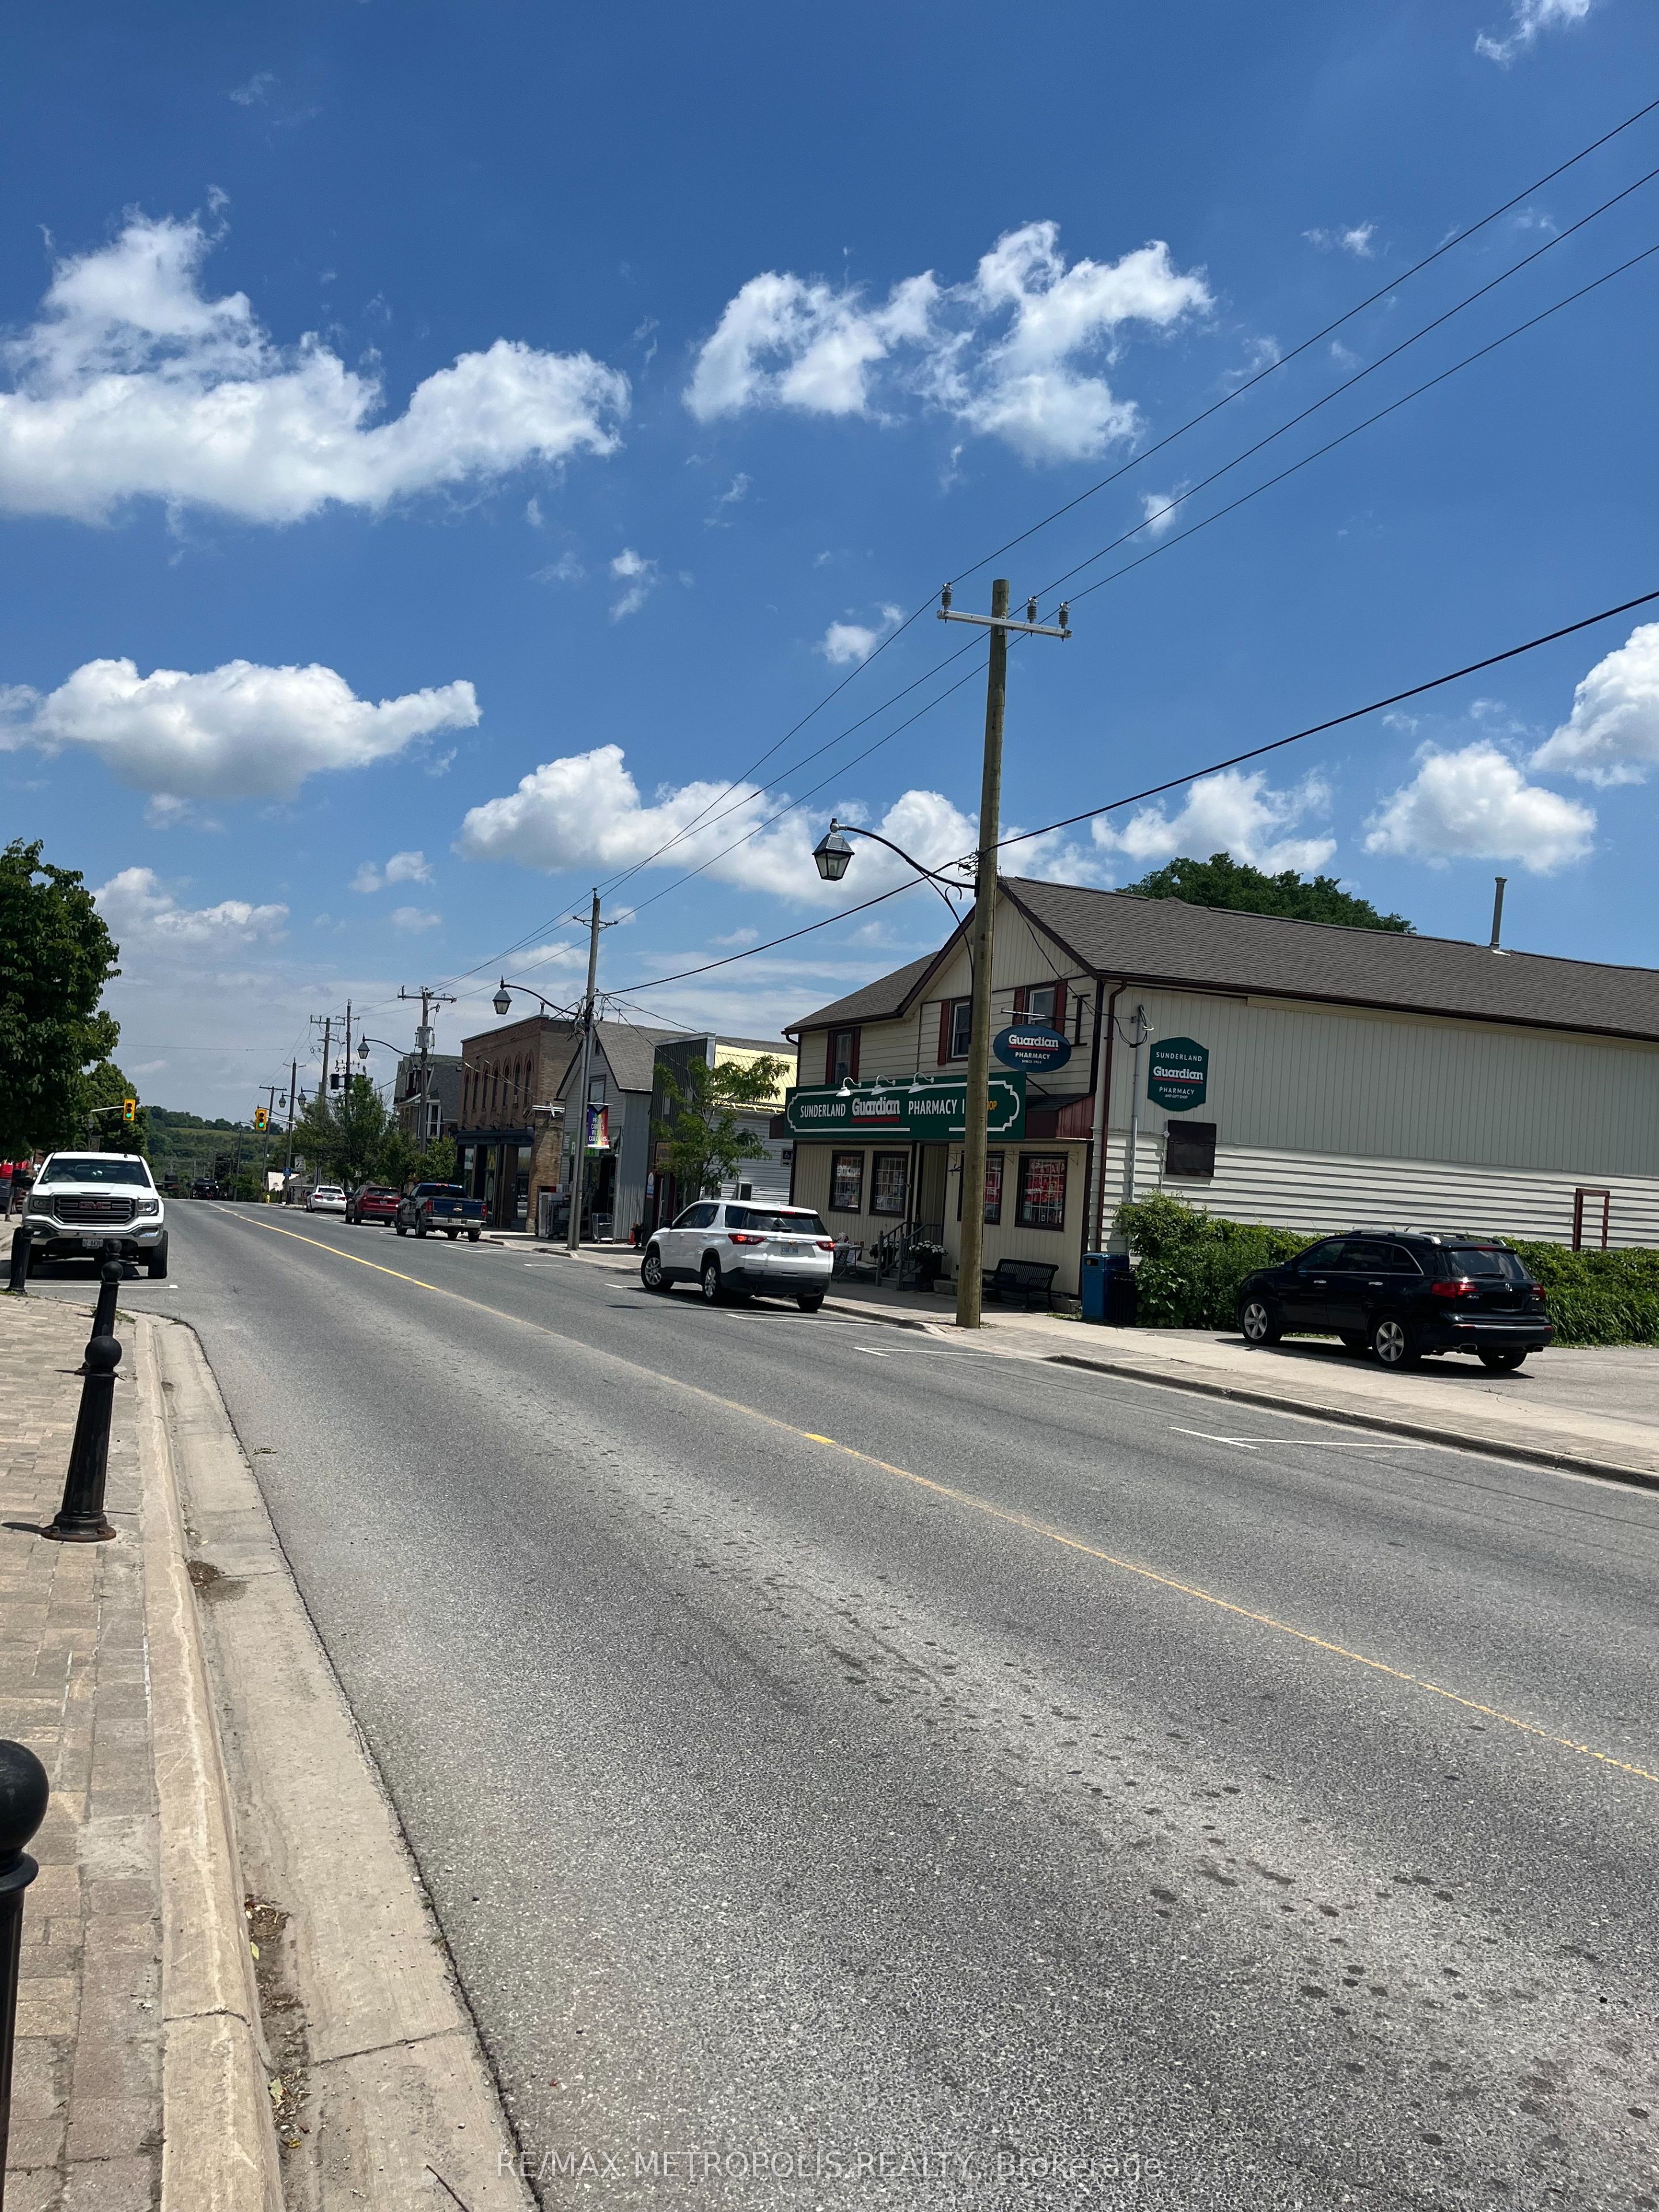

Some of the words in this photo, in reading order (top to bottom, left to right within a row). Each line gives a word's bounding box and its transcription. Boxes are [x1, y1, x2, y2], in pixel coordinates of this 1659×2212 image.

[1009, 1034, 1059, 1047] Guardian
[1156, 1052, 1202, 1062] SUNDERLAND
[1153, 1066, 1203, 1080] Guardian
[1159, 1086, 1195, 1094] PHARMACY
[800, 1103, 846, 1118] SUNDERLAND
[852, 1097, 900, 1116] Guardian
[908, 1099, 958, 1115] PHARMACY
